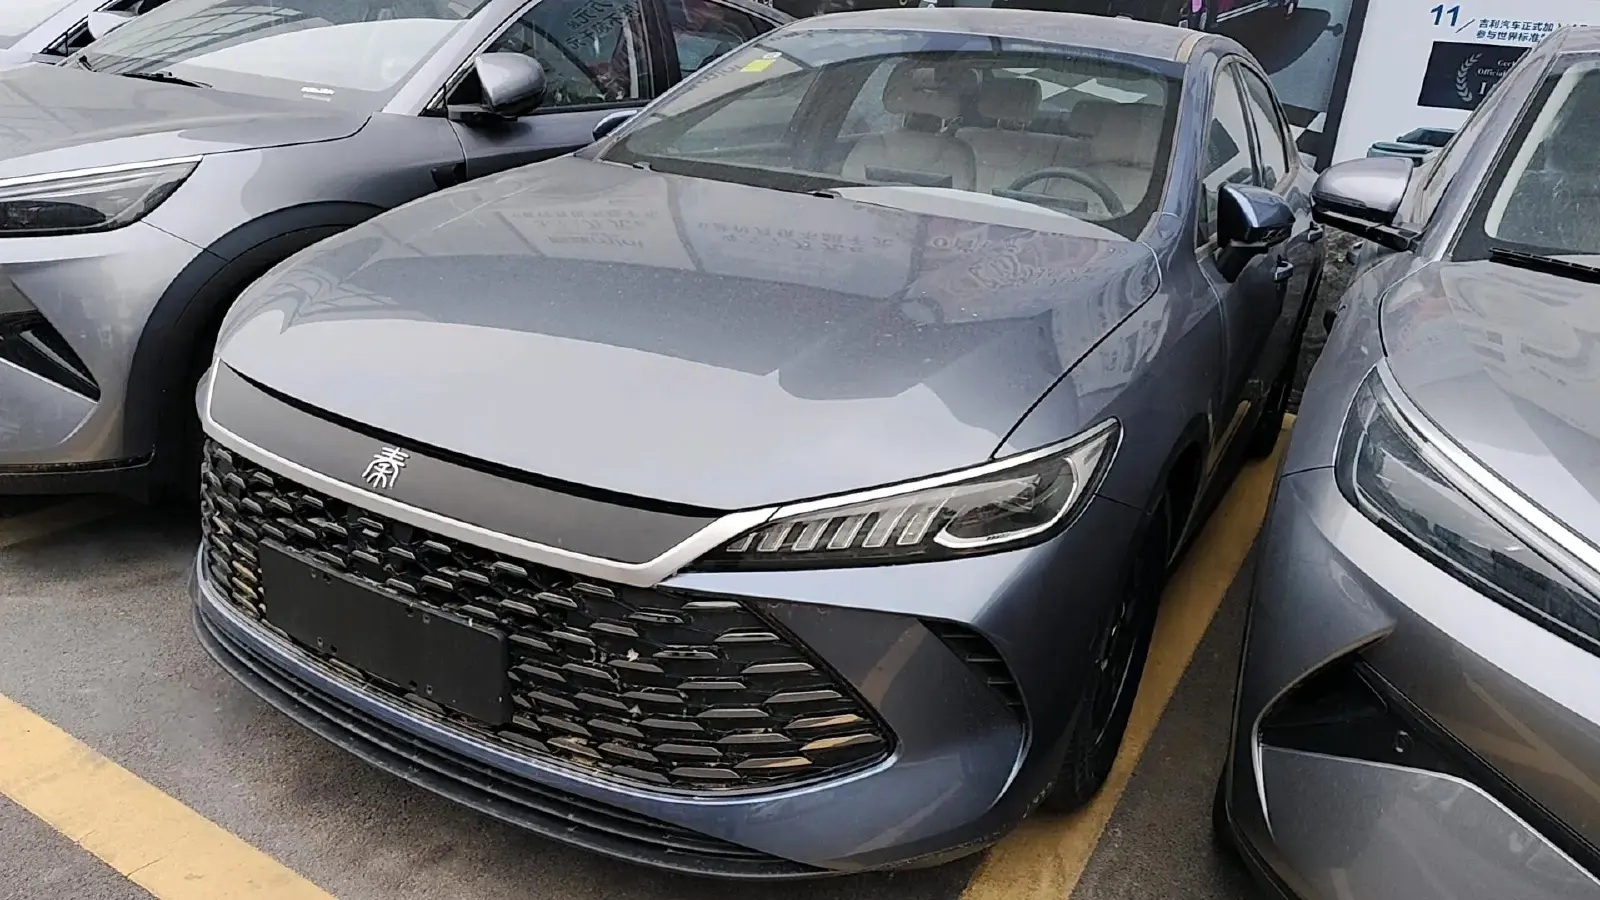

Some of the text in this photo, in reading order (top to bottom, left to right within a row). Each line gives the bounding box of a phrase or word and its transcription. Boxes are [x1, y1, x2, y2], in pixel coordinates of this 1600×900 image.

[1430, 4, 1460, 26] 11
[1478, 18, 1587, 32] 吉利汽车正式加
[1476, 30, 1546, 43] 参与世界标准
